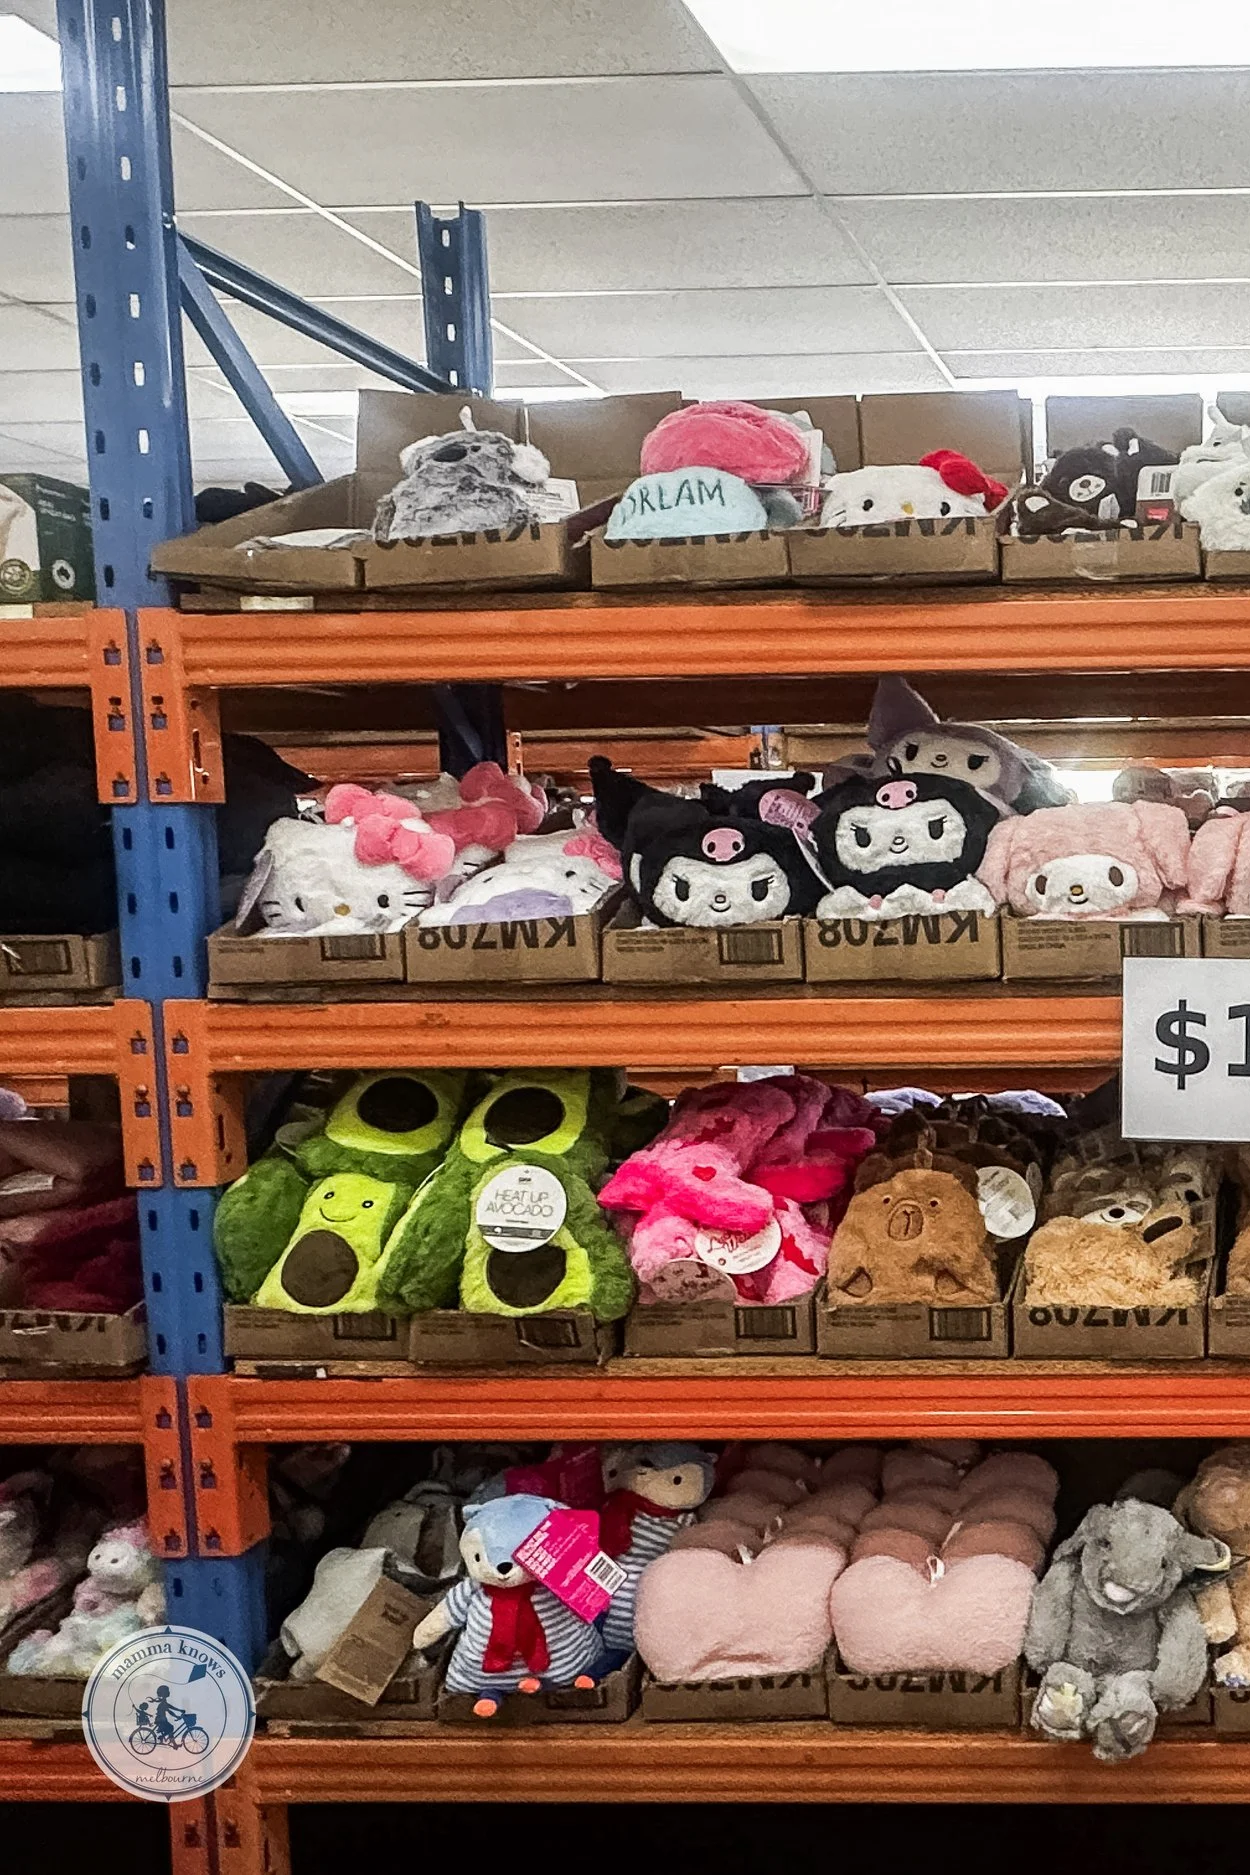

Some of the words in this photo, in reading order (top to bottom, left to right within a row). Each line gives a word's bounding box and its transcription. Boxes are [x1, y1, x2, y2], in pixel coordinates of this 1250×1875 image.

[495, 1188, 527, 1202] HEAT
[530, 1191, 549, 1203] UP
[485, 1201, 554, 1217] AVOCADO
